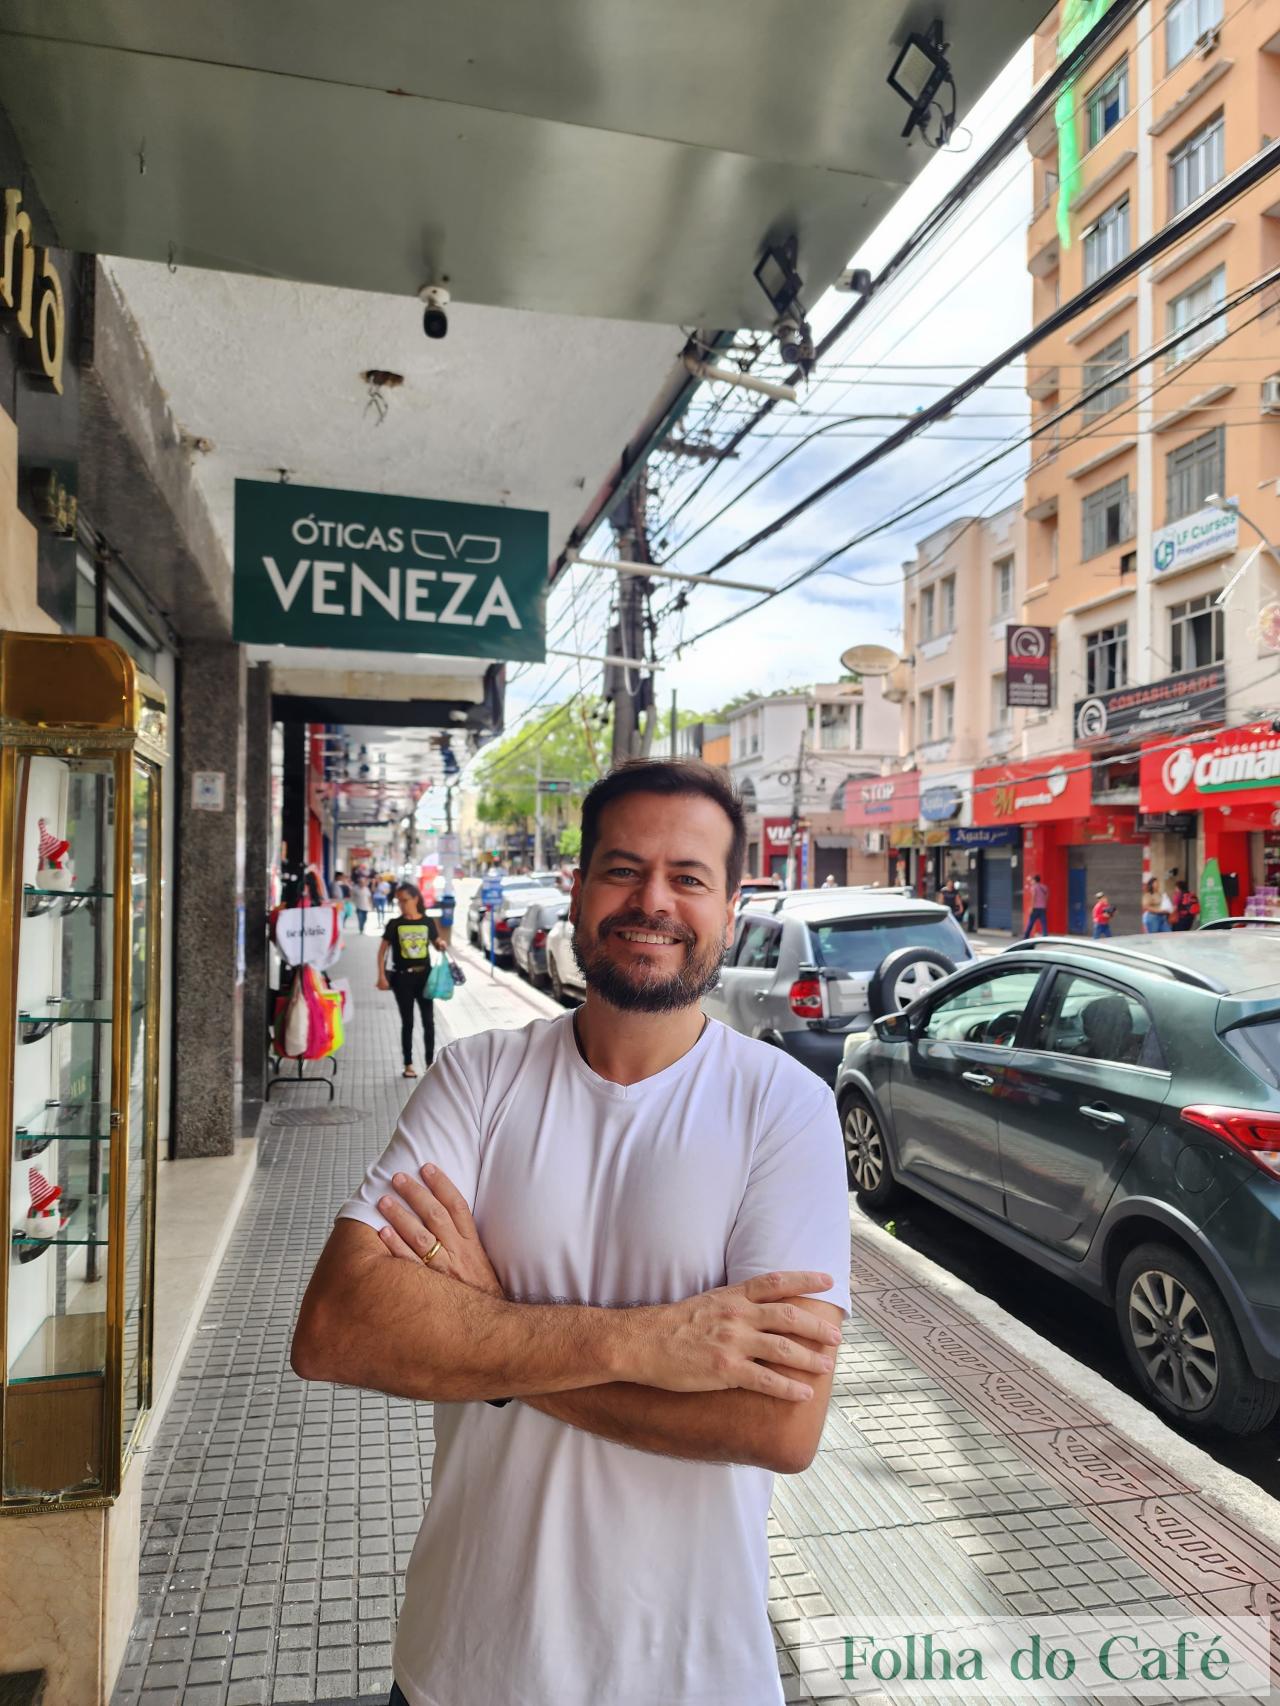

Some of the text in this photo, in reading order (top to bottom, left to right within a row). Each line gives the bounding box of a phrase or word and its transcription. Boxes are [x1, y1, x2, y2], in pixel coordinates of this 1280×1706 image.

[291, 513, 405, 553] ÓTICAS
[1191, 512, 1237, 539] Cursos
[261, 556, 523, 630] VENEZA
[861, 782, 895, 802] STOP
